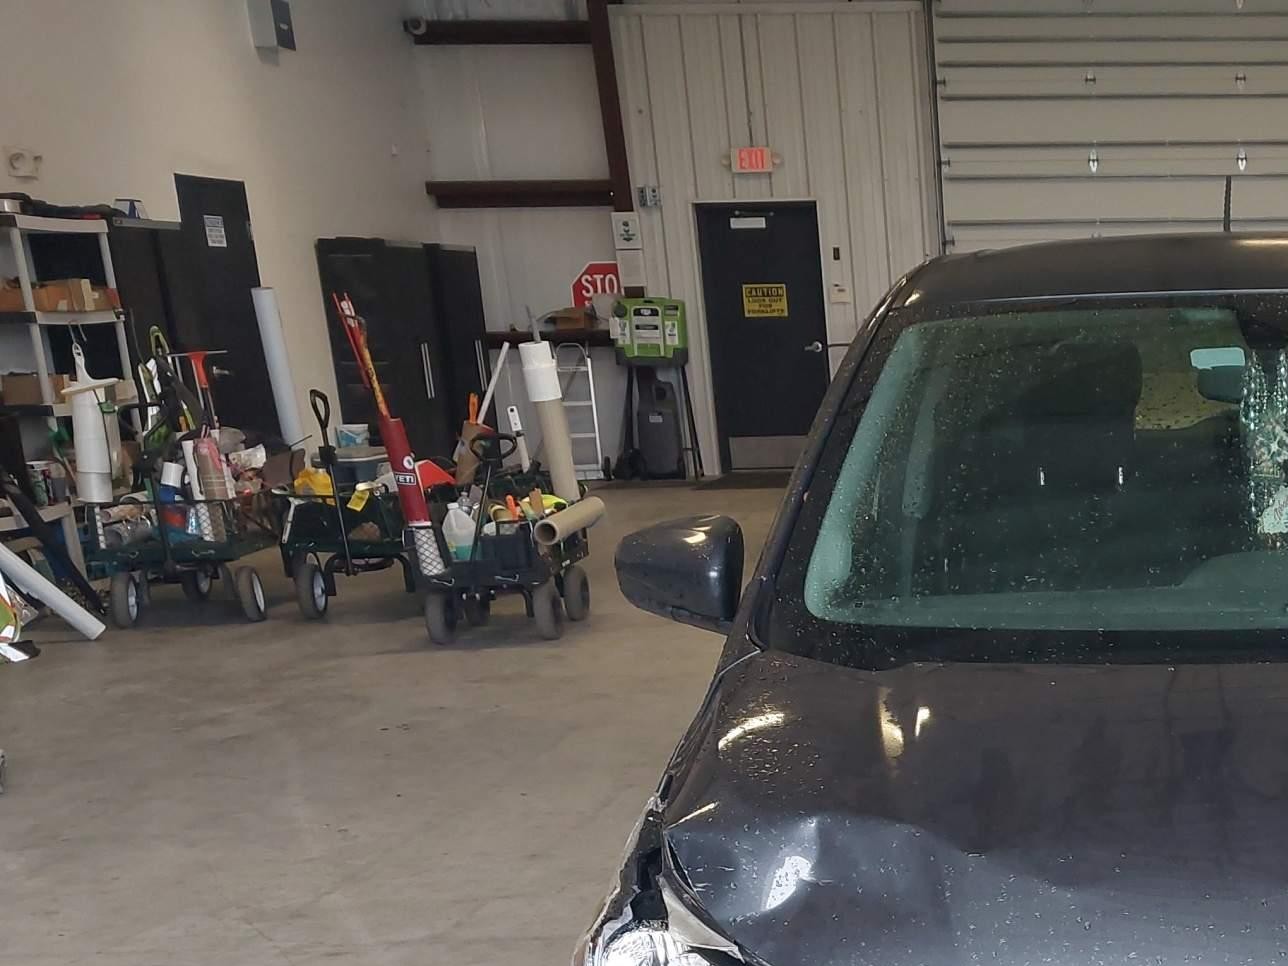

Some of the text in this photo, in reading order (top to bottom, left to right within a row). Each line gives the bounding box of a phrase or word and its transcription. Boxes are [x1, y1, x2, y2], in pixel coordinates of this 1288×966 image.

[738, 148, 764, 169] EXIT
[581, 273, 624, 297] STO
[745, 287, 784, 296] CAUTION
